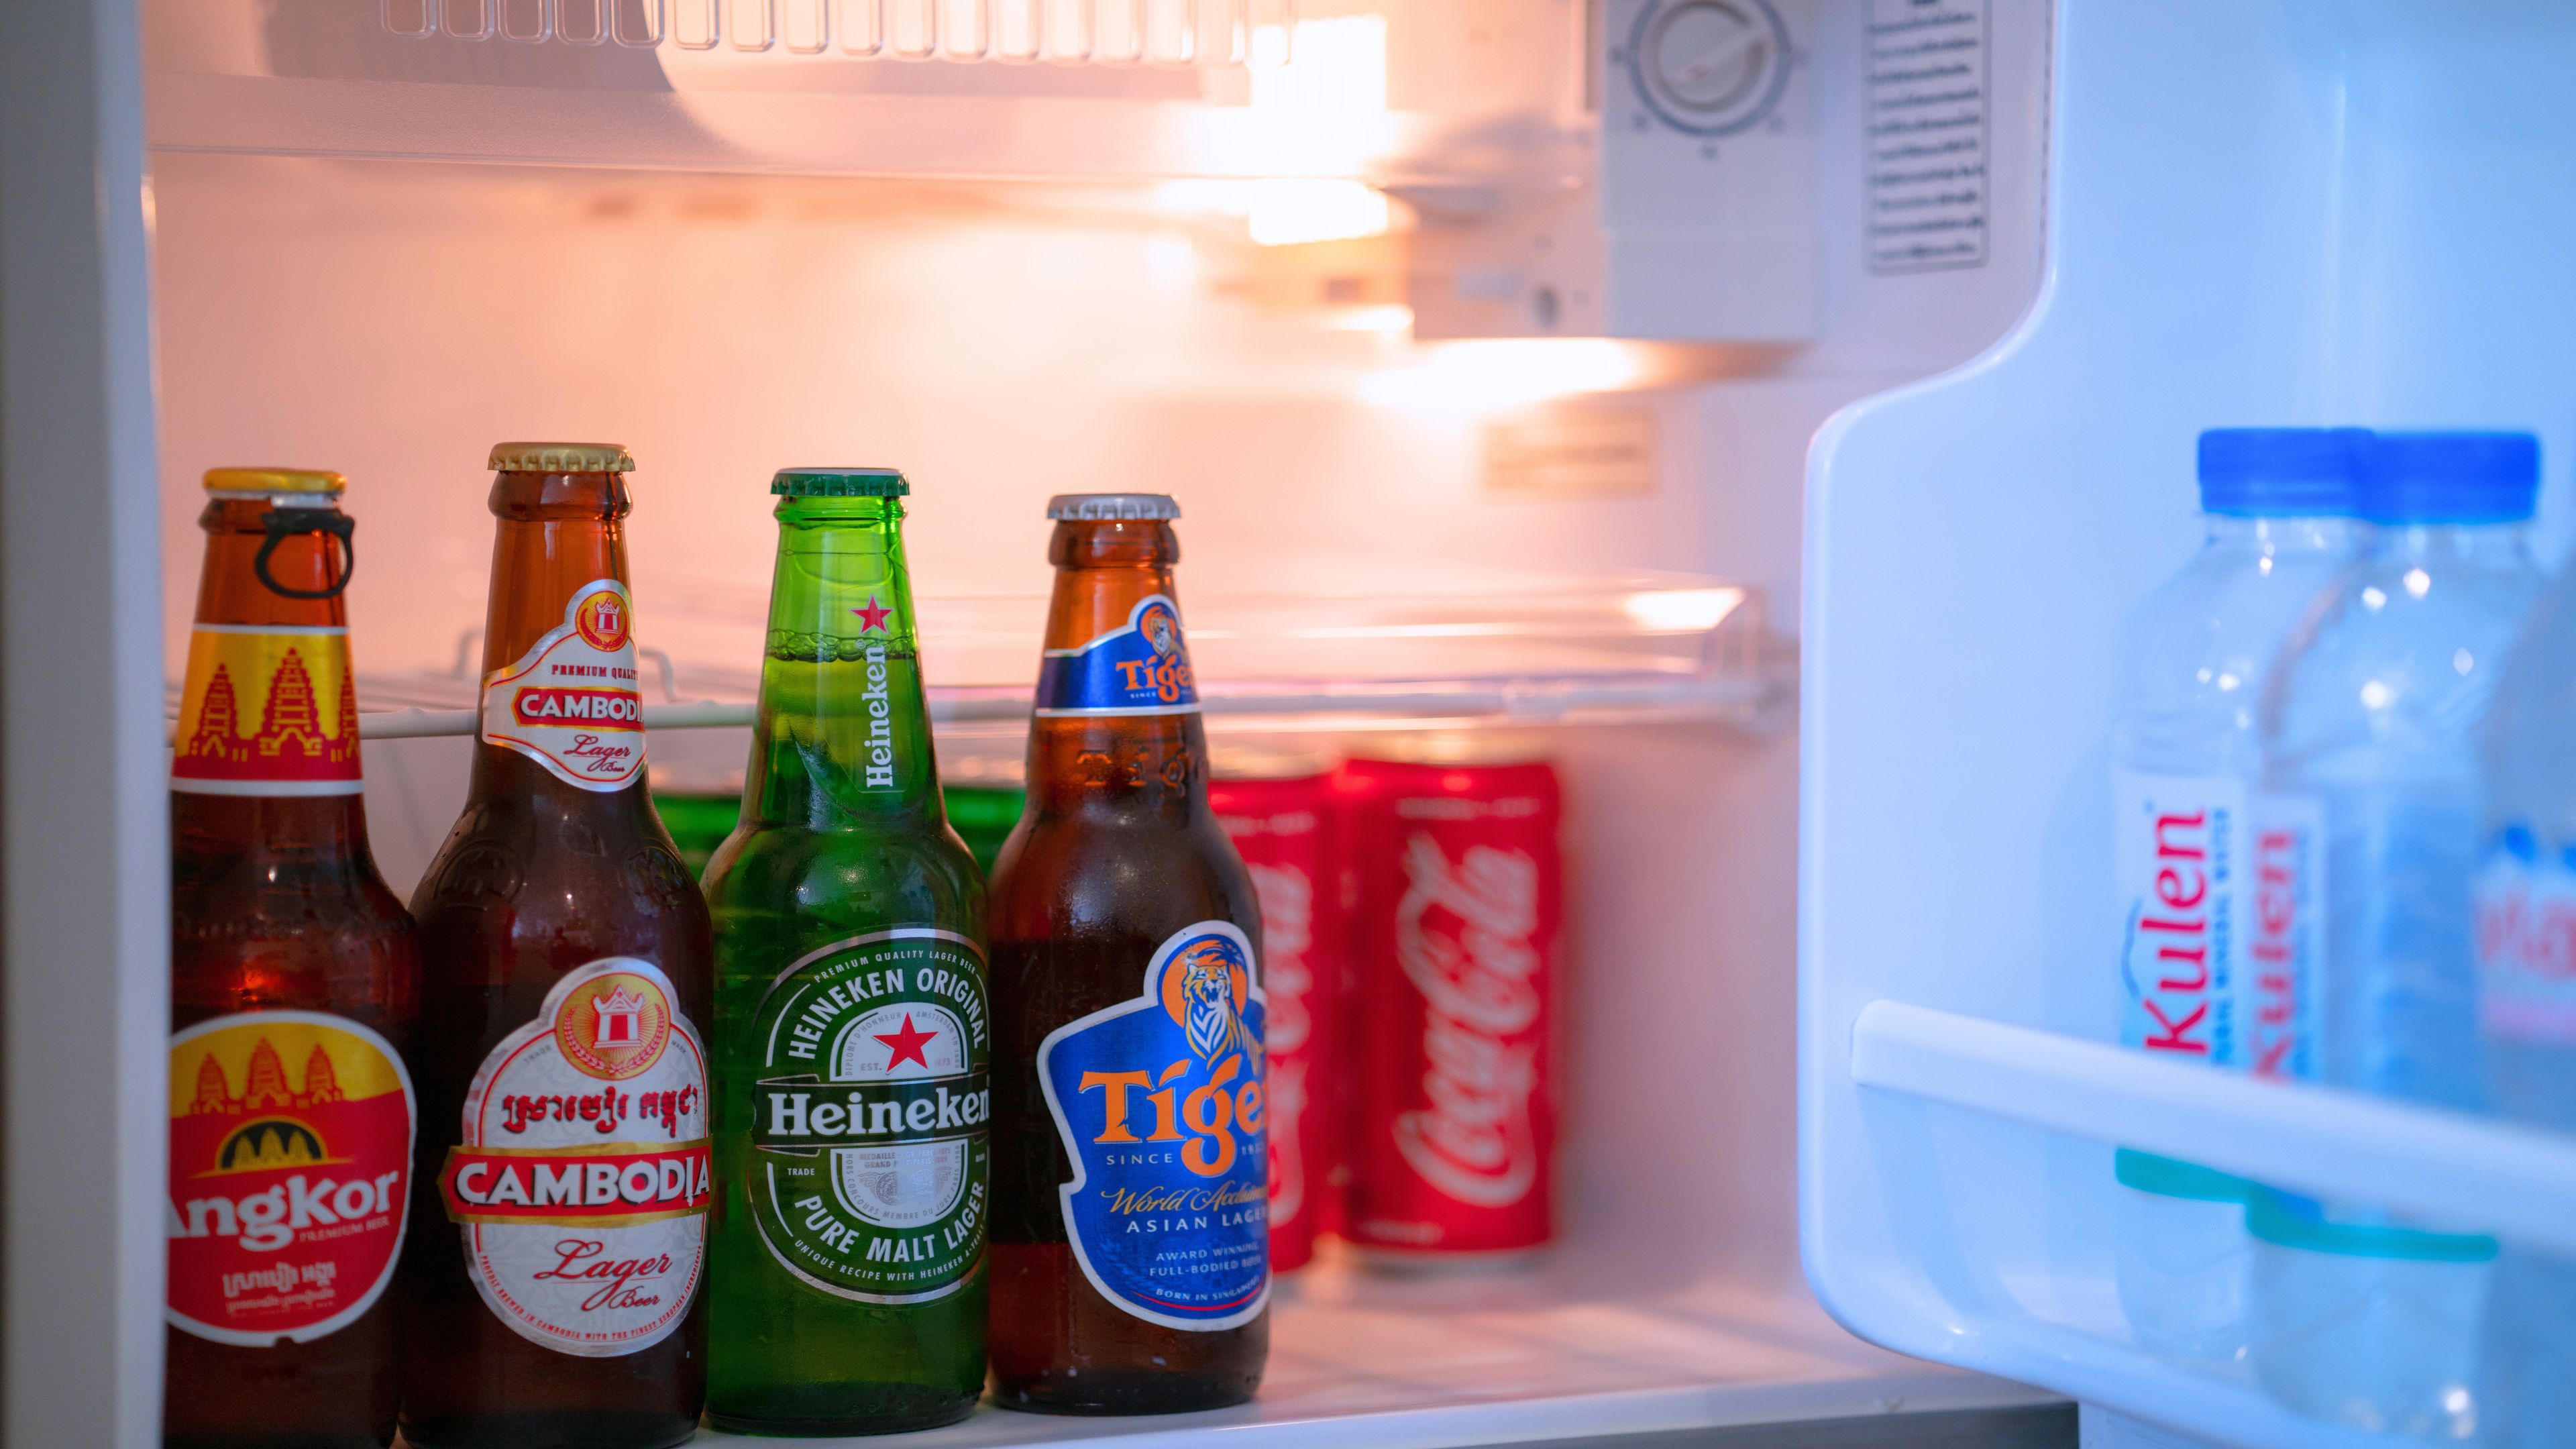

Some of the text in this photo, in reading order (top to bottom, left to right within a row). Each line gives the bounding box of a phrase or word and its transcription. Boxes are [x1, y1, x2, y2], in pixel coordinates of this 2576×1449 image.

[551, 664, 607, 678] PREMIUM
[1115, 654, 1191, 702] Tige
[861, 645, 894, 788] Heineken
[564, 734, 631, 772] Lager
[600, 761, 625, 772] Beer
[2139, 809, 2209, 1055] Kulen
[814, 950, 976, 983] PREMIUM QUALITY LAGER BEER
[788, 967, 985, 1060] HEINEKEN ORIGINAL
[523, 1040, 687, 1064] TRADE MARK
[845, 1040, 857, 1076] DIPLOME
[854, 1012, 902, 1038] D'HONNEUR
[916, 1011, 955, 1034] AMSTERDAM
[953, 1036, 959, 1046] EN
[861, 1063, 882, 1071] EST.
[768, 1087, 989, 1136] Heineken
[1078, 1053, 1267, 1179] Tige
[846, 1154, 854, 1174] HORS
[859, 1152, 896, 1161] MEDAILLE
[1106, 1142, 1266, 1165] SINCE 19
[455, 1155, 710, 1207] CAMBODIA
[788, 1168, 815, 1176] TRADE
[847, 1179, 879, 1216] CONCOURS
[936, 1194, 952, 1211] JURY
[1101, 1185, 1186, 1216] World
[794, 1181, 984, 1263] PURE MALT LAGER
[882, 1211, 919, 1220] MEMBRE
[1126, 1217, 1208, 1234] ASIAN
[794, 1240, 835, 1269] UNIQUE
[839, 1265, 881, 1281] RECIPE
[887, 1273, 914, 1281] WITH
[920, 1255, 963, 1279] HEINEKEN
[1149, 1260, 1239, 1277] FULL-BODIED
[1156, 1250, 1208, 1262] AWARD
[533, 1239, 673, 1312] Lager
[481, 1256, 501, 1288] PROUDLY
[498, 1289, 525, 1315] BREWED
[525, 1313, 535, 1323] IN
[537, 1320, 581, 1340] CAMBODIA
[585, 1332, 607, 1340] WITH
[611, 1331, 627, 1340] THE
[631, 1321, 657, 1336] FINEST
[659, 1295, 686, 1324] EUROPEAN
[608, 1285, 661, 1309] Beer
[1156, 1288, 1191, 1300] BORN
